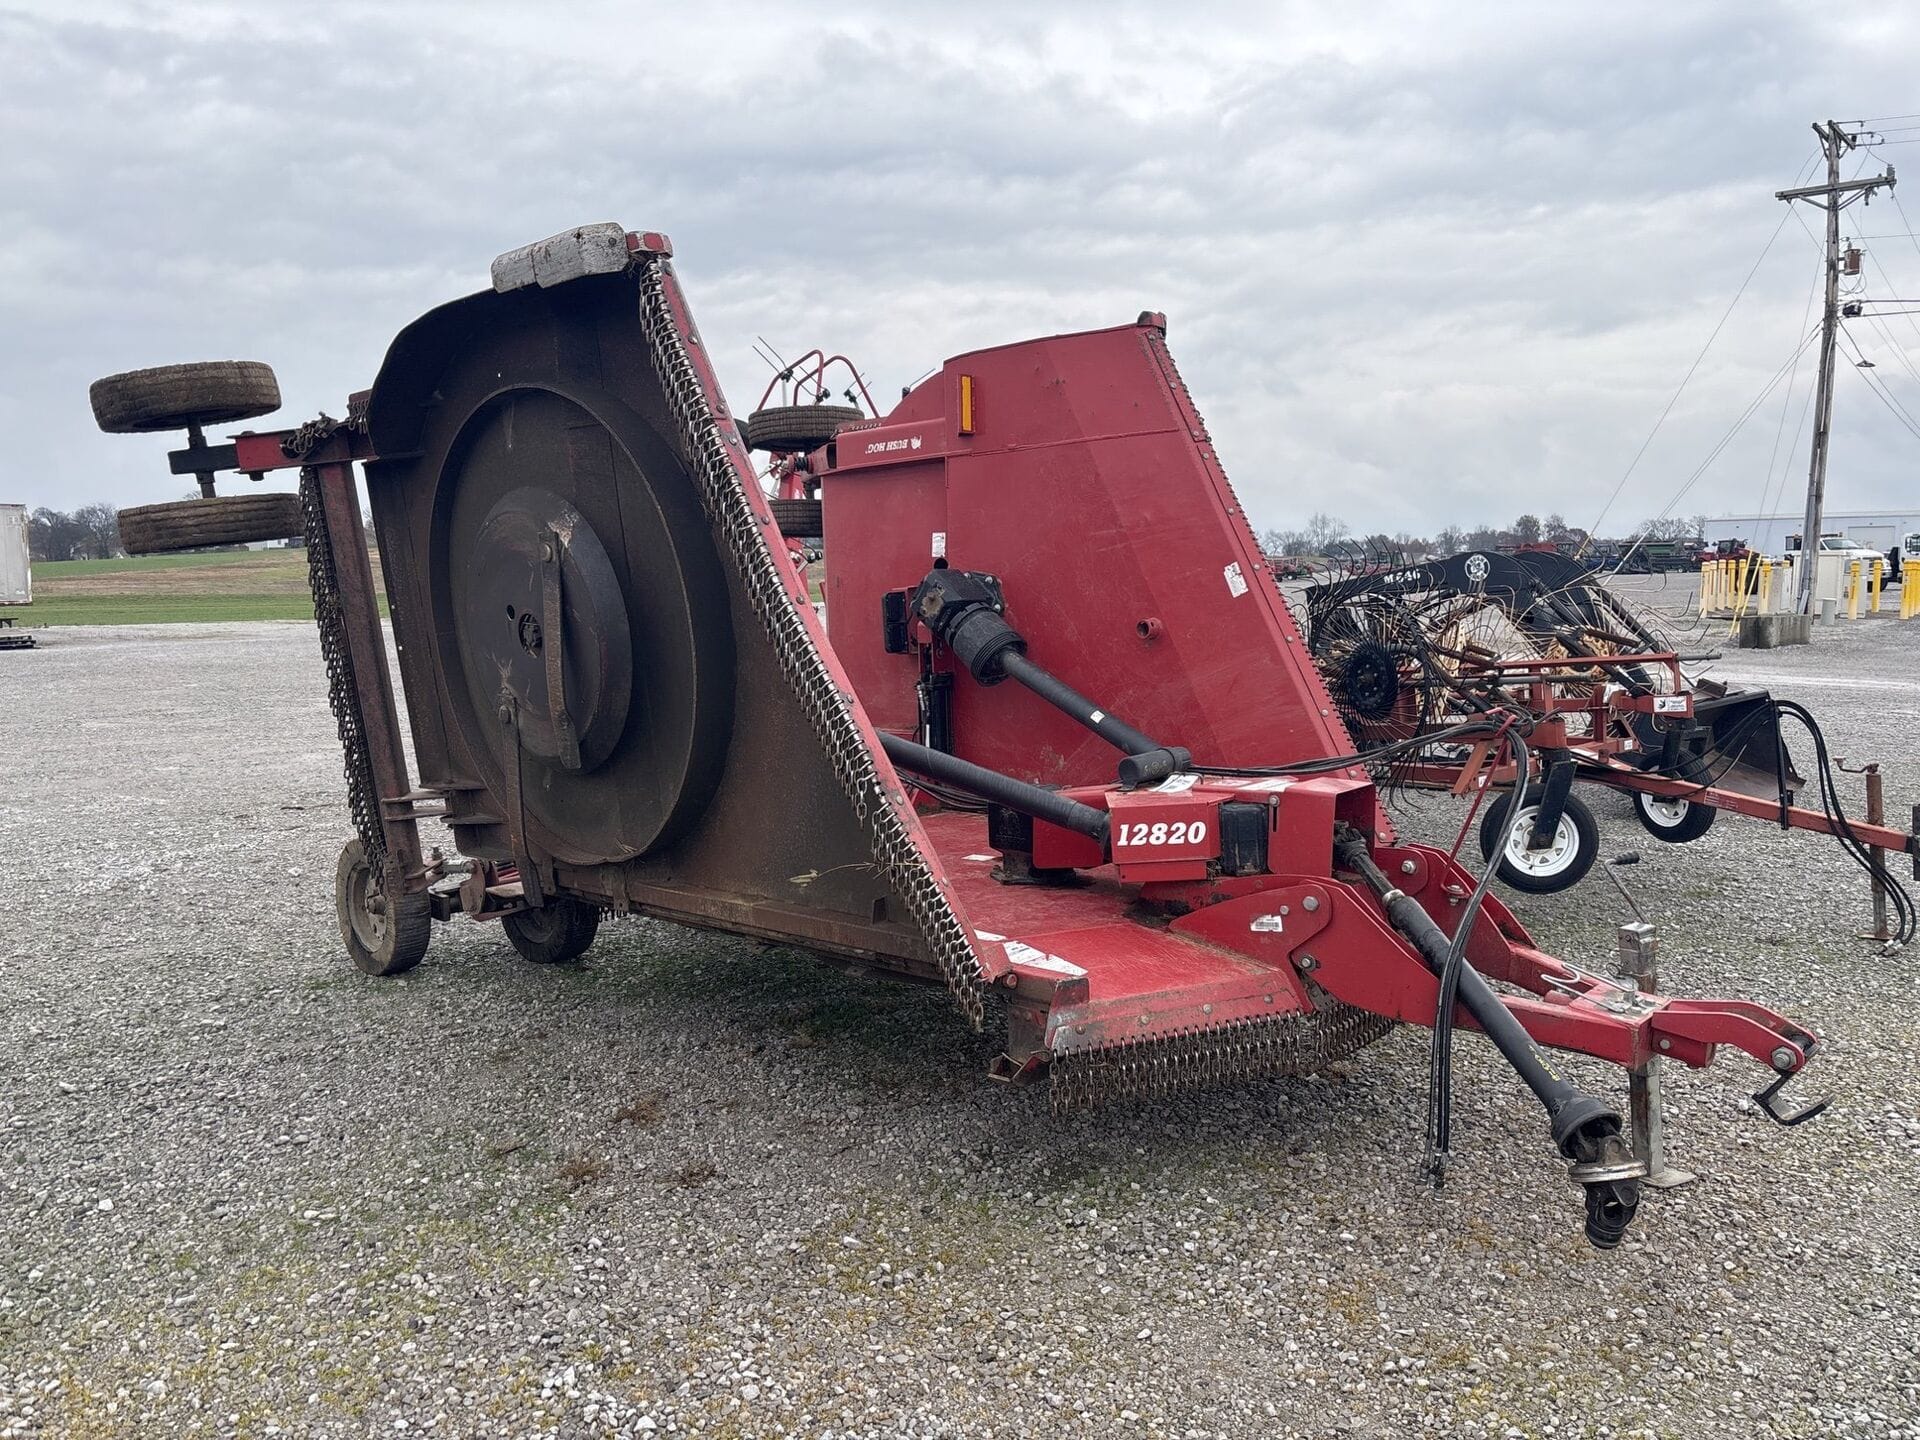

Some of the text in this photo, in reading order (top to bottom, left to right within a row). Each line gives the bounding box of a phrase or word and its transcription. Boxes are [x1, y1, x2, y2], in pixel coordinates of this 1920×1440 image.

[867, 439, 909, 454] BUSH HOG
[1117, 821, 1207, 847] 12820
